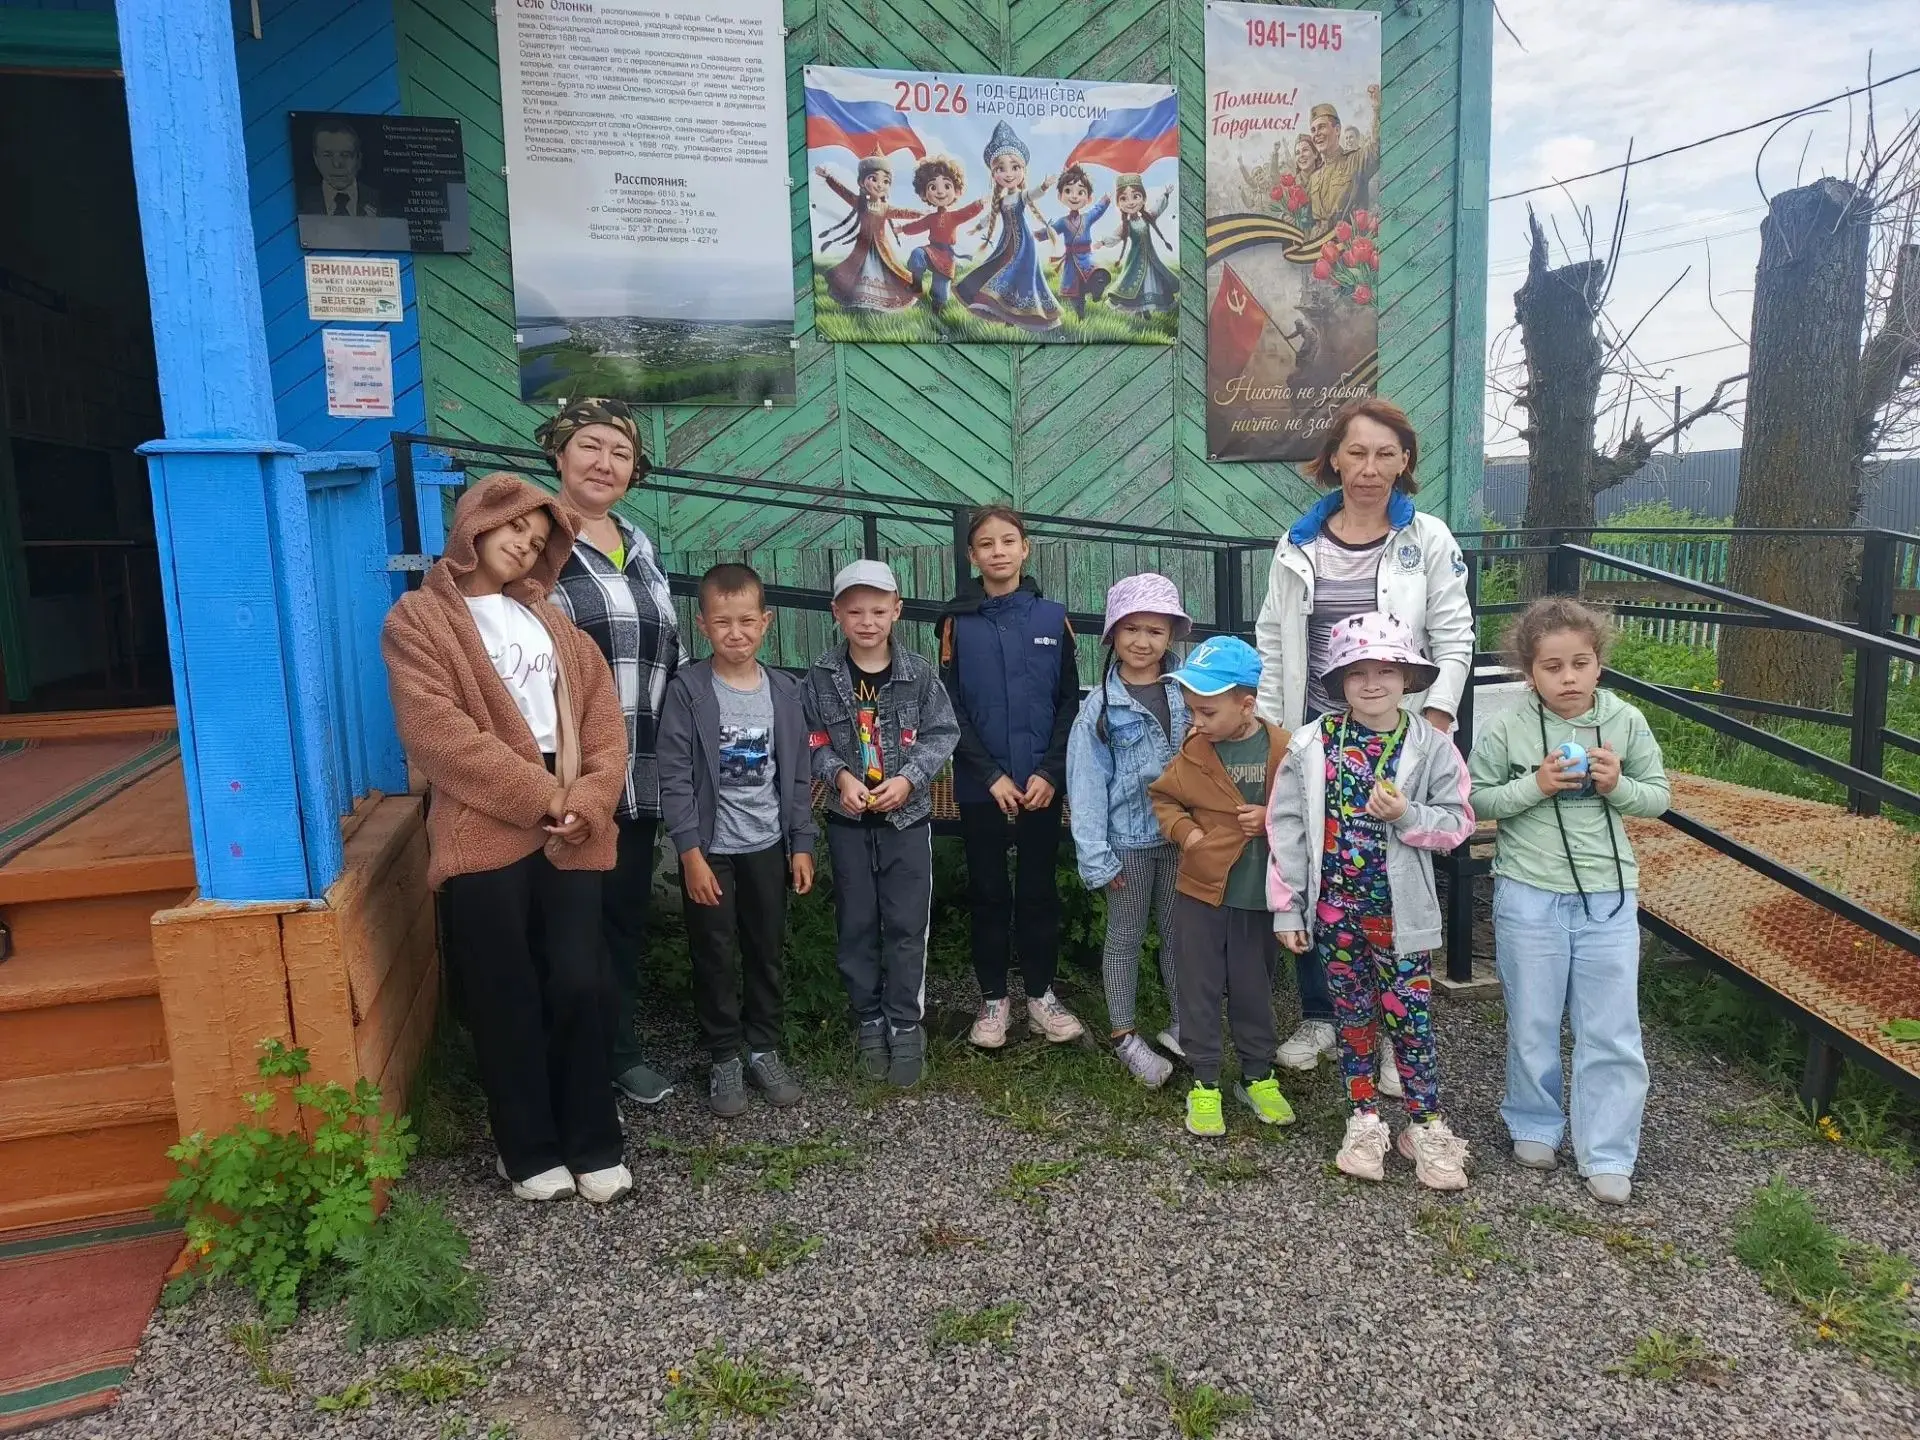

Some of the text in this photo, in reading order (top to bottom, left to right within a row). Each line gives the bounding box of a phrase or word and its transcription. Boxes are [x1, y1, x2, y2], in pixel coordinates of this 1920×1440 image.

[1246, 19, 1344, 51] 1941-1945
[894, 81, 1085, 114] 2026 ГОД ЕДИНСТВА
[1213, 87, 1298, 112] Помним!
[976, 101, 1108, 120] НАРОДОВ РОССИИ
[1211, 112, 1300, 140] Гордимся!
[614, 173, 688, 187] Расстояния:
[311, 263, 394, 278] ВНИМАНИЕ!
[320, 296, 366, 305] ВЕДЕТСЯ
[1213, 375, 1294, 406] Никто
[1296, 386, 1315, 400] не
[1231, 416, 1282, 433] ничто
[1284, 418, 1302, 431] не
